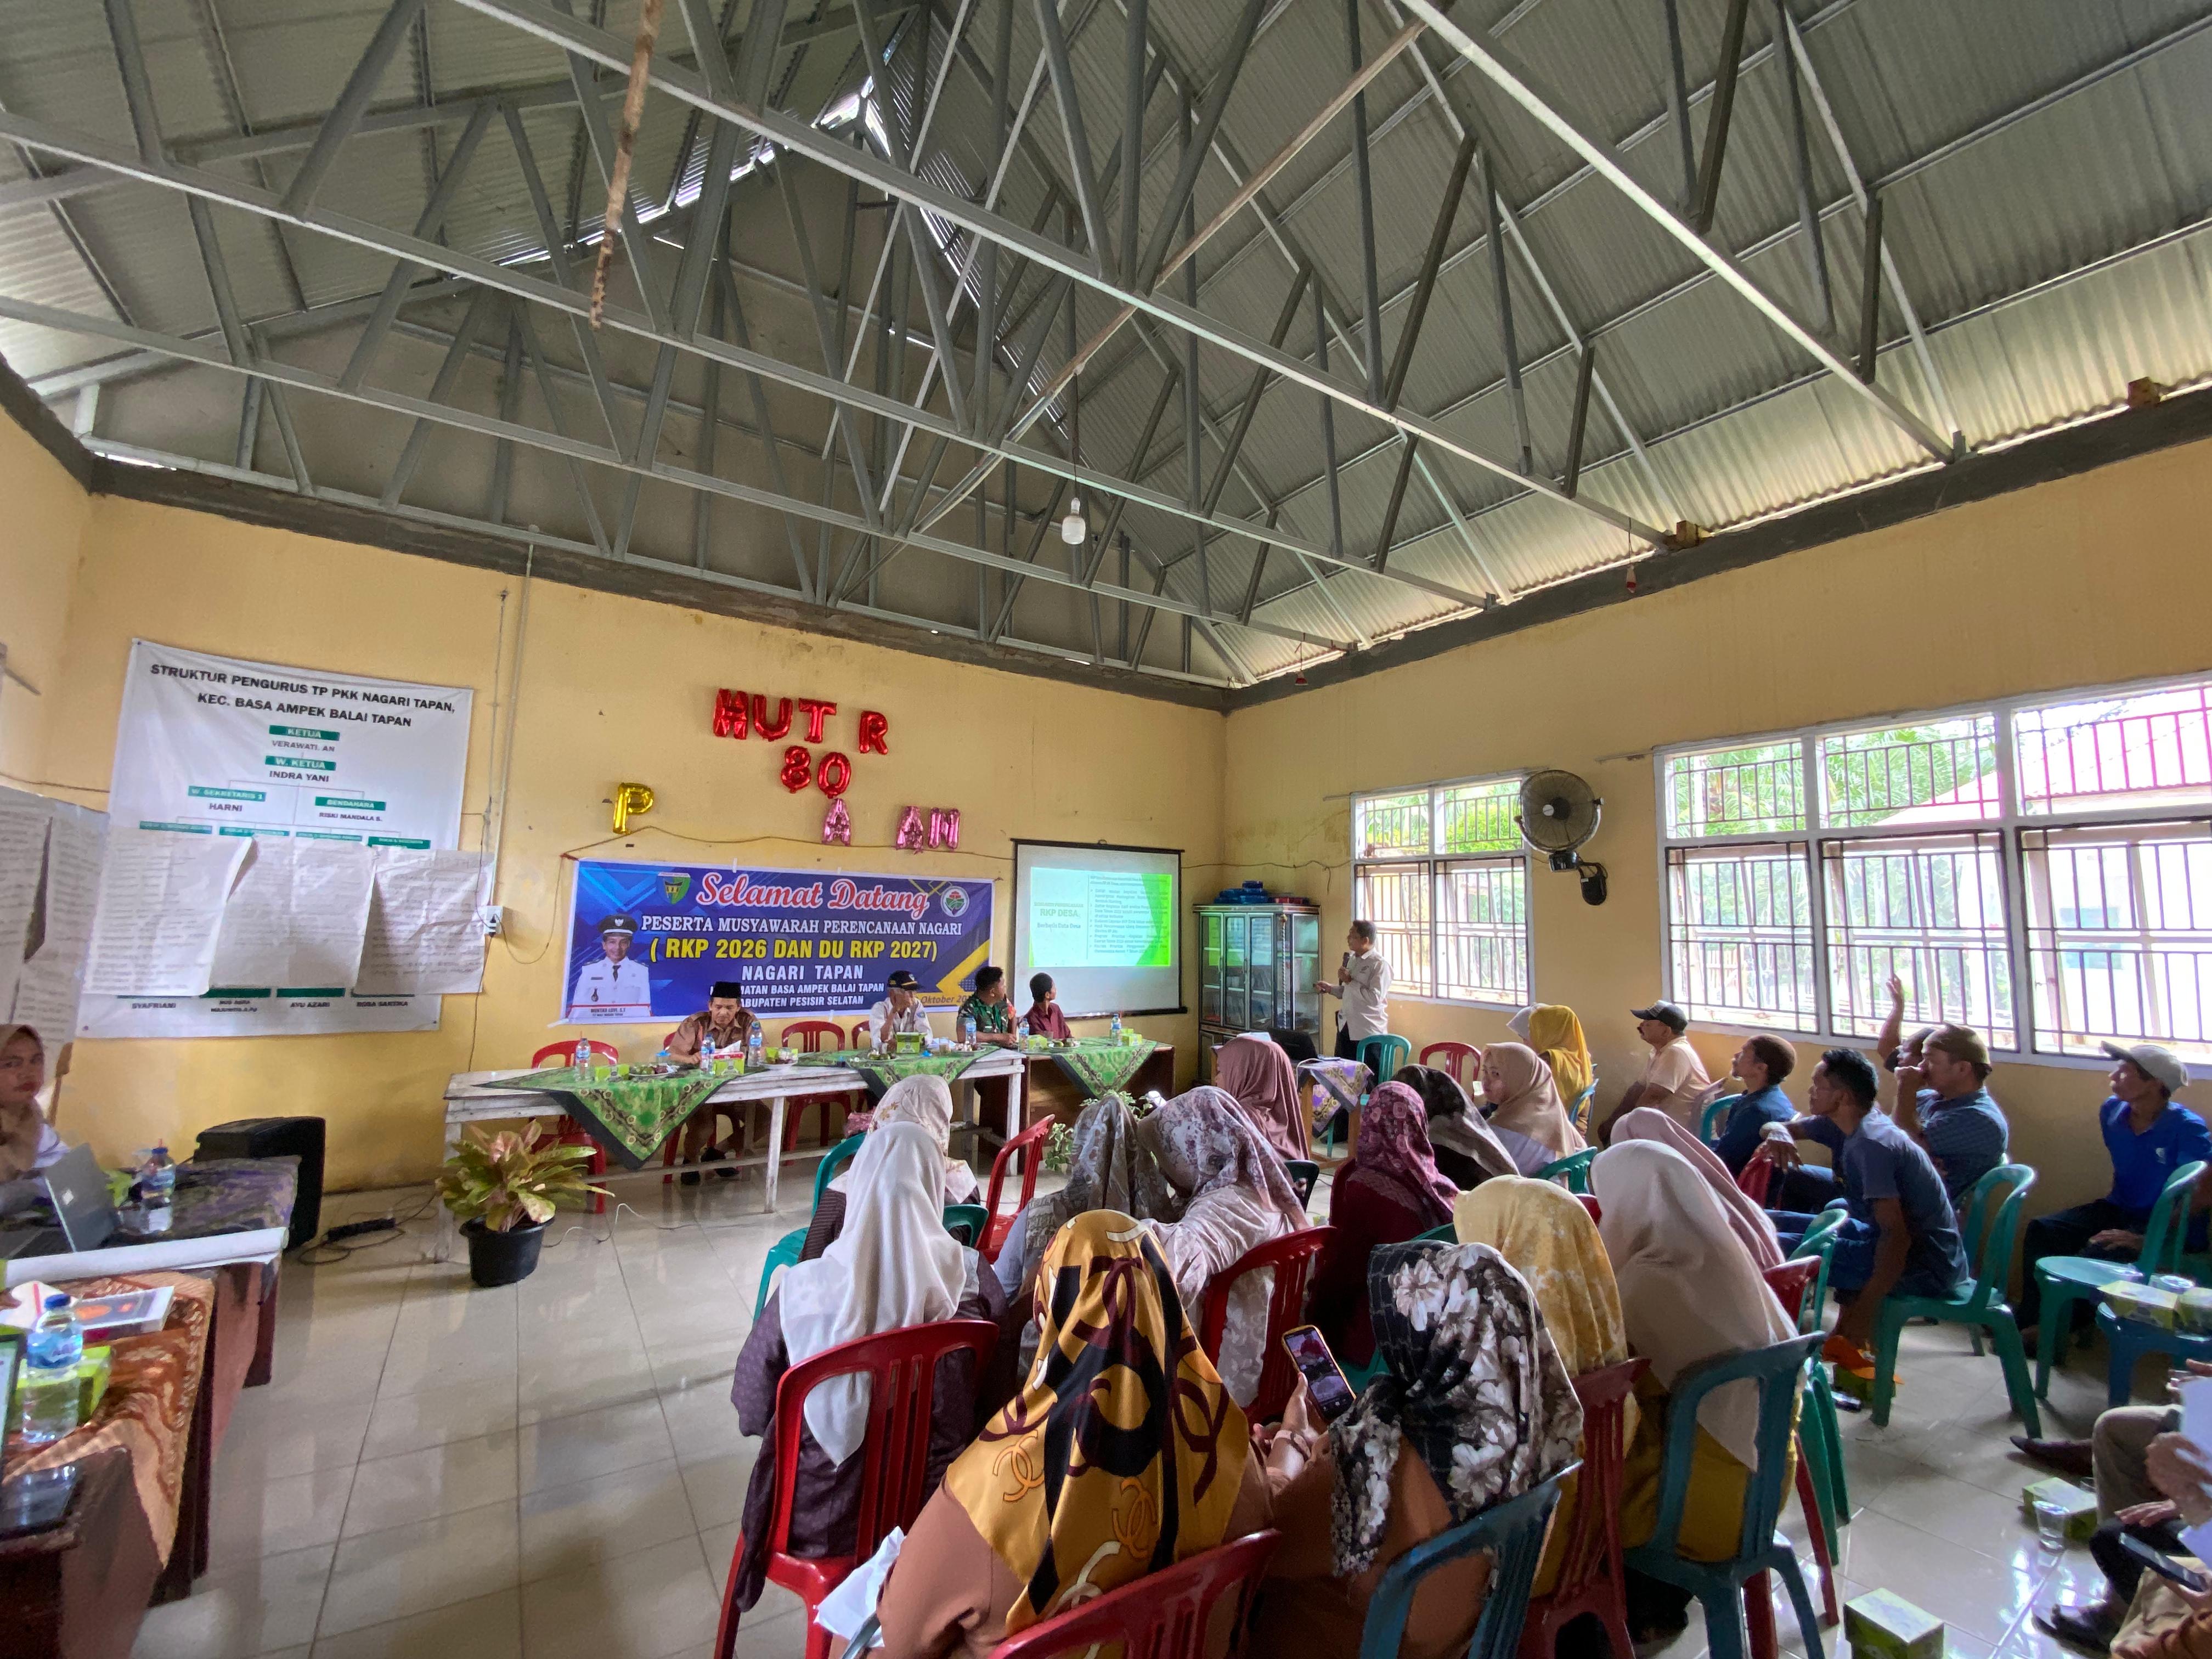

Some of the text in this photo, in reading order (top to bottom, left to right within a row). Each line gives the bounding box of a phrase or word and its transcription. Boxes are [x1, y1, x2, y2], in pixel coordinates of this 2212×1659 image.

[151, 663, 455, 714] STRUKTUR PENGURUS TP PKK NAGARI TAPAN,
[198, 692, 411, 727] KEC. BASA AMPEK BALAI TAPAN
[713, 688, 889, 755] HUT R
[287, 728, 321, 738] KETUA
[291, 760, 326, 769] KETUA
[781, 745, 851, 799] 80
[269, 770, 329, 782] INDRA YANI
[209, 803, 242, 812] HARNI
[326, 799, 375, 809] BENDAHARA
[613, 782, 654, 834] P
[822, 798, 851, 847] A
[697, 872, 929, 920] Selamat Datang
[641, 916, 962, 935] PESERTA MUSYAWARAH PERENCANAAN NAGARI
[665, 938, 709, 958] RKP
[715, 939, 767, 958] 2026
[774, 939, 812, 958] DAN
[819, 940, 844, 958] DU
[850, 940, 885, 958] RKP
[890, 940, 938, 962] 2027)
[742, 965, 863, 981] NAGARI TAPAN
[771, 985, 794, 994] BASA
[797, 984, 829, 994] AMPEK
[831, 984, 856, 993] BALAI
[858, 983, 885, 992] TAPAN
[741, 995, 864, 1008] ABUPATEN PESISIR SELATAN
[921, 995, 955, 1003] Oktober
